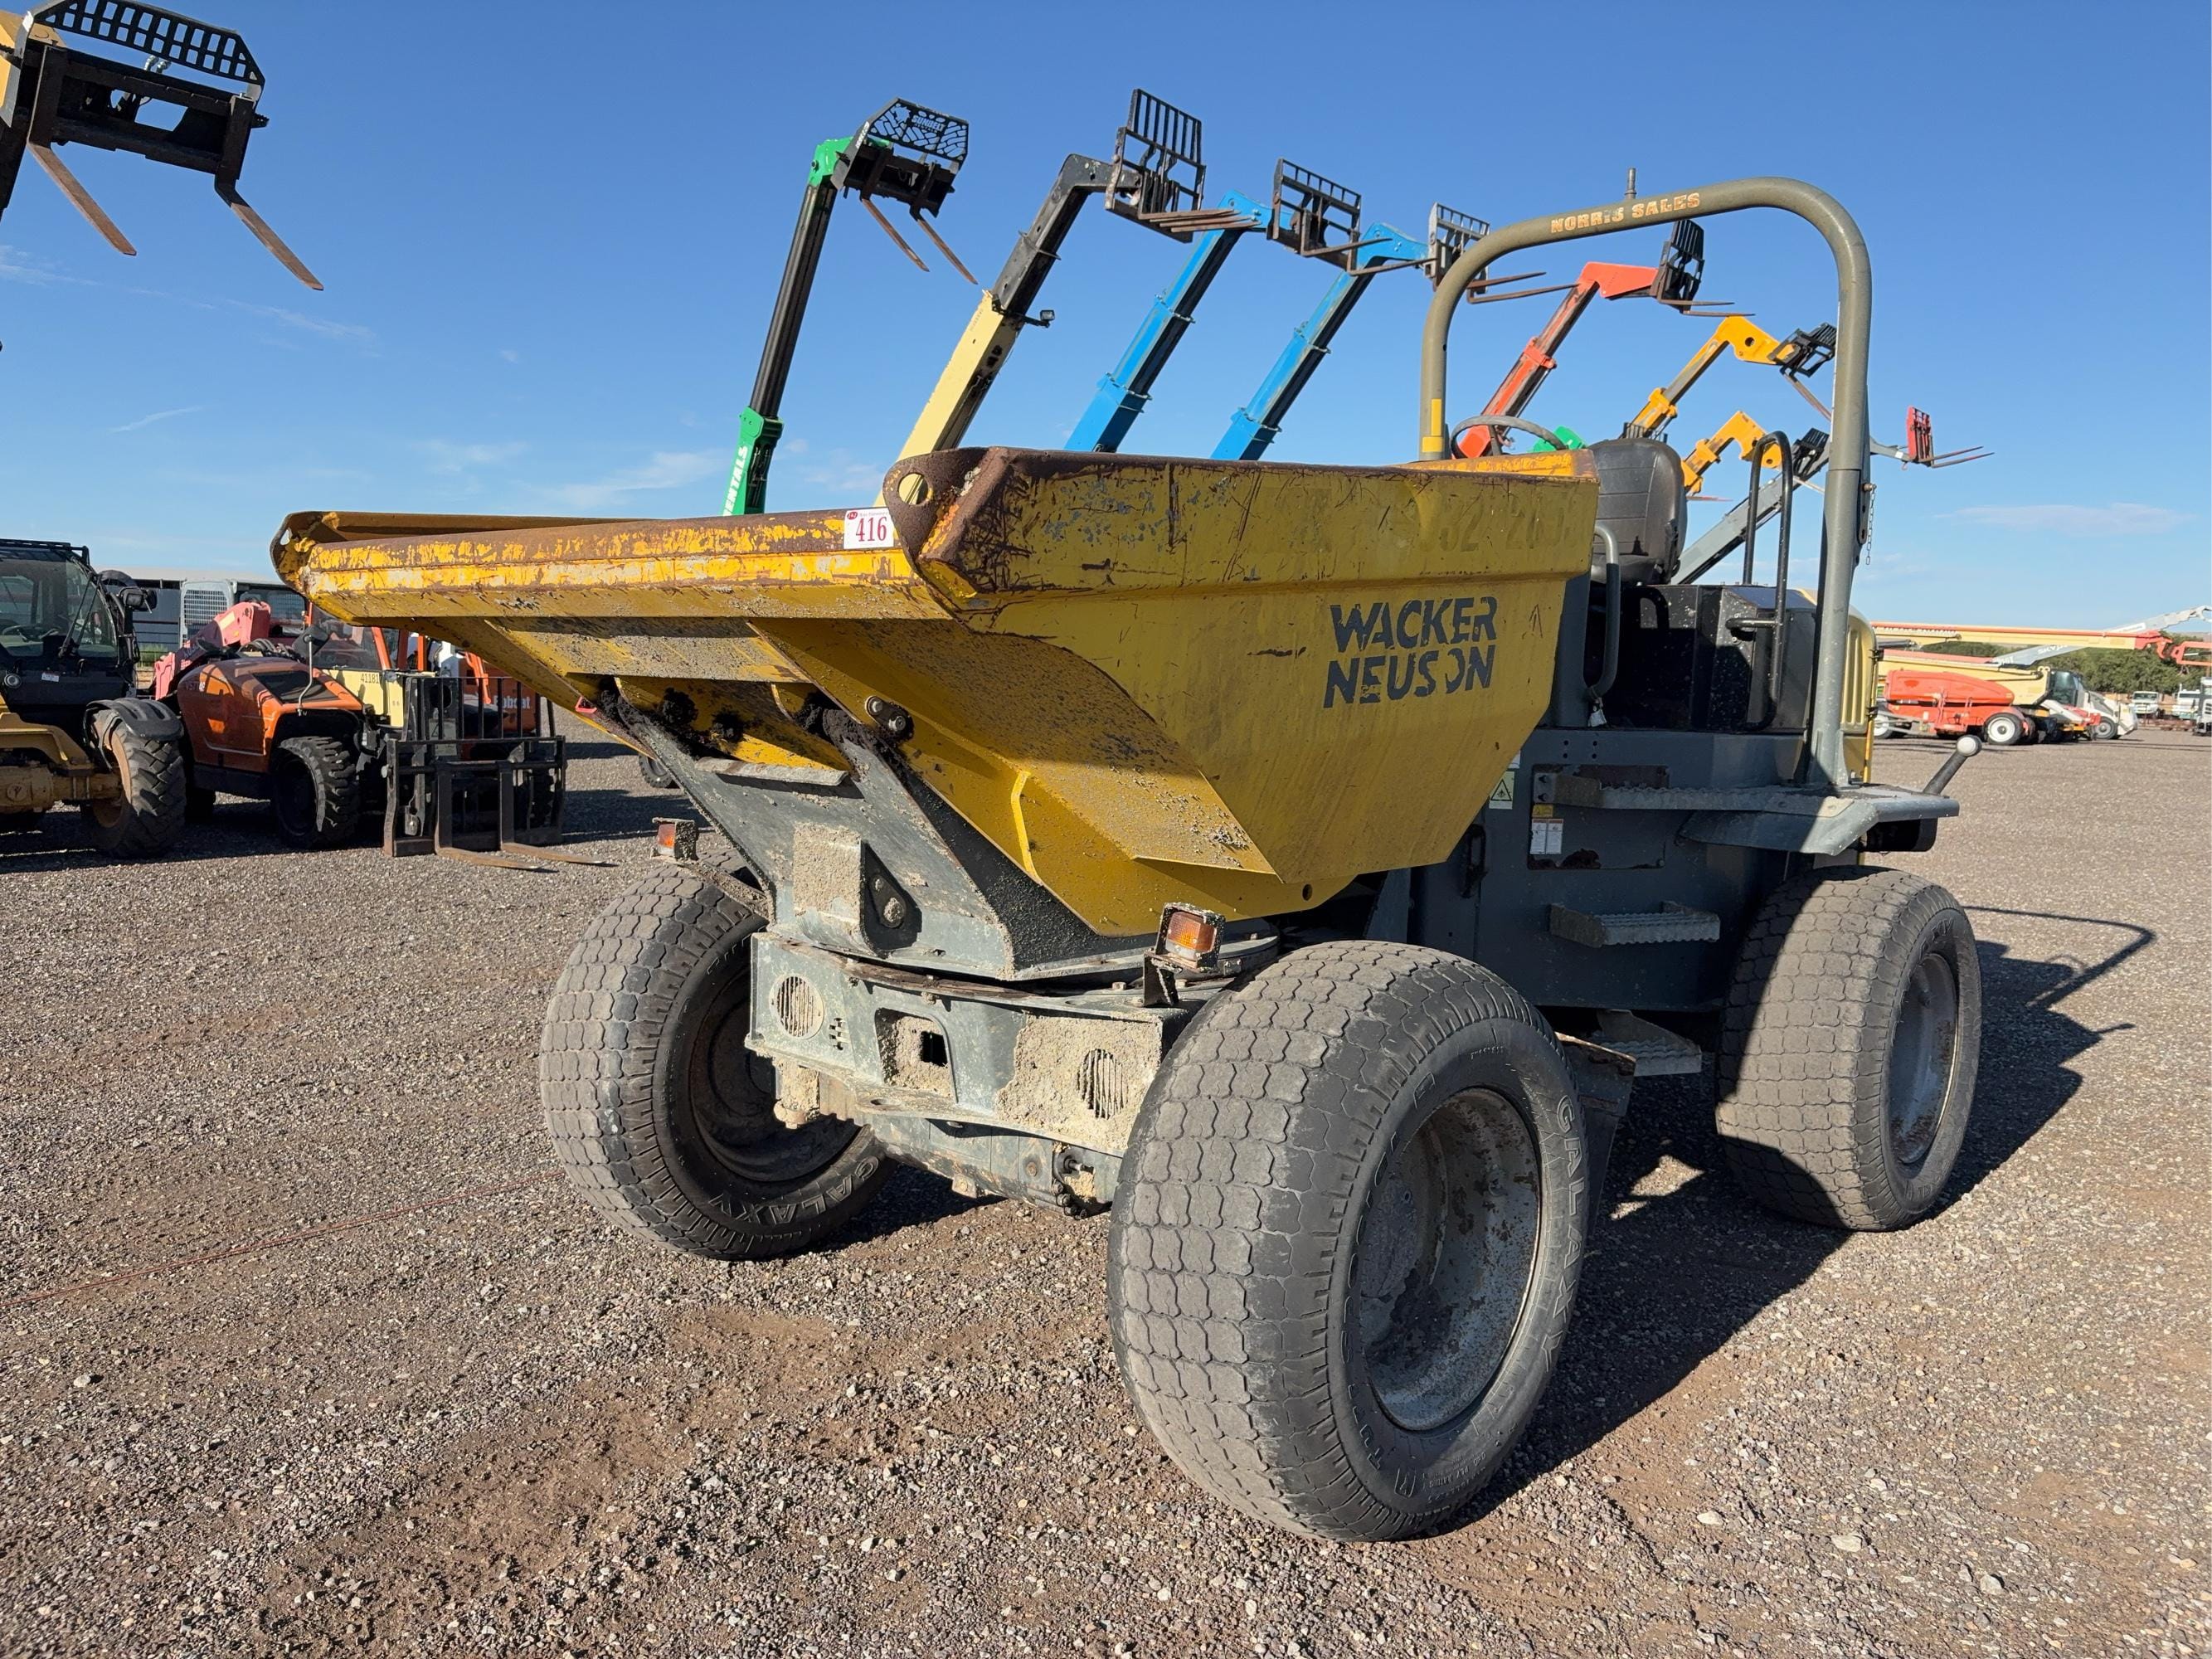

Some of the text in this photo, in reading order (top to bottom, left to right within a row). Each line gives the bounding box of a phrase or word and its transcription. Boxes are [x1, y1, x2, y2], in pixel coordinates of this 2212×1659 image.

[1631, 192, 1700, 218] SALES
[855, 516, 887, 542] 416
[1330, 596, 1498, 653] WACKER
[1323, 644, 1496, 708] NEUSON
[707, 1155, 880, 1226] GALAXY
[1541, 1094, 1586, 1373] GALAXY
